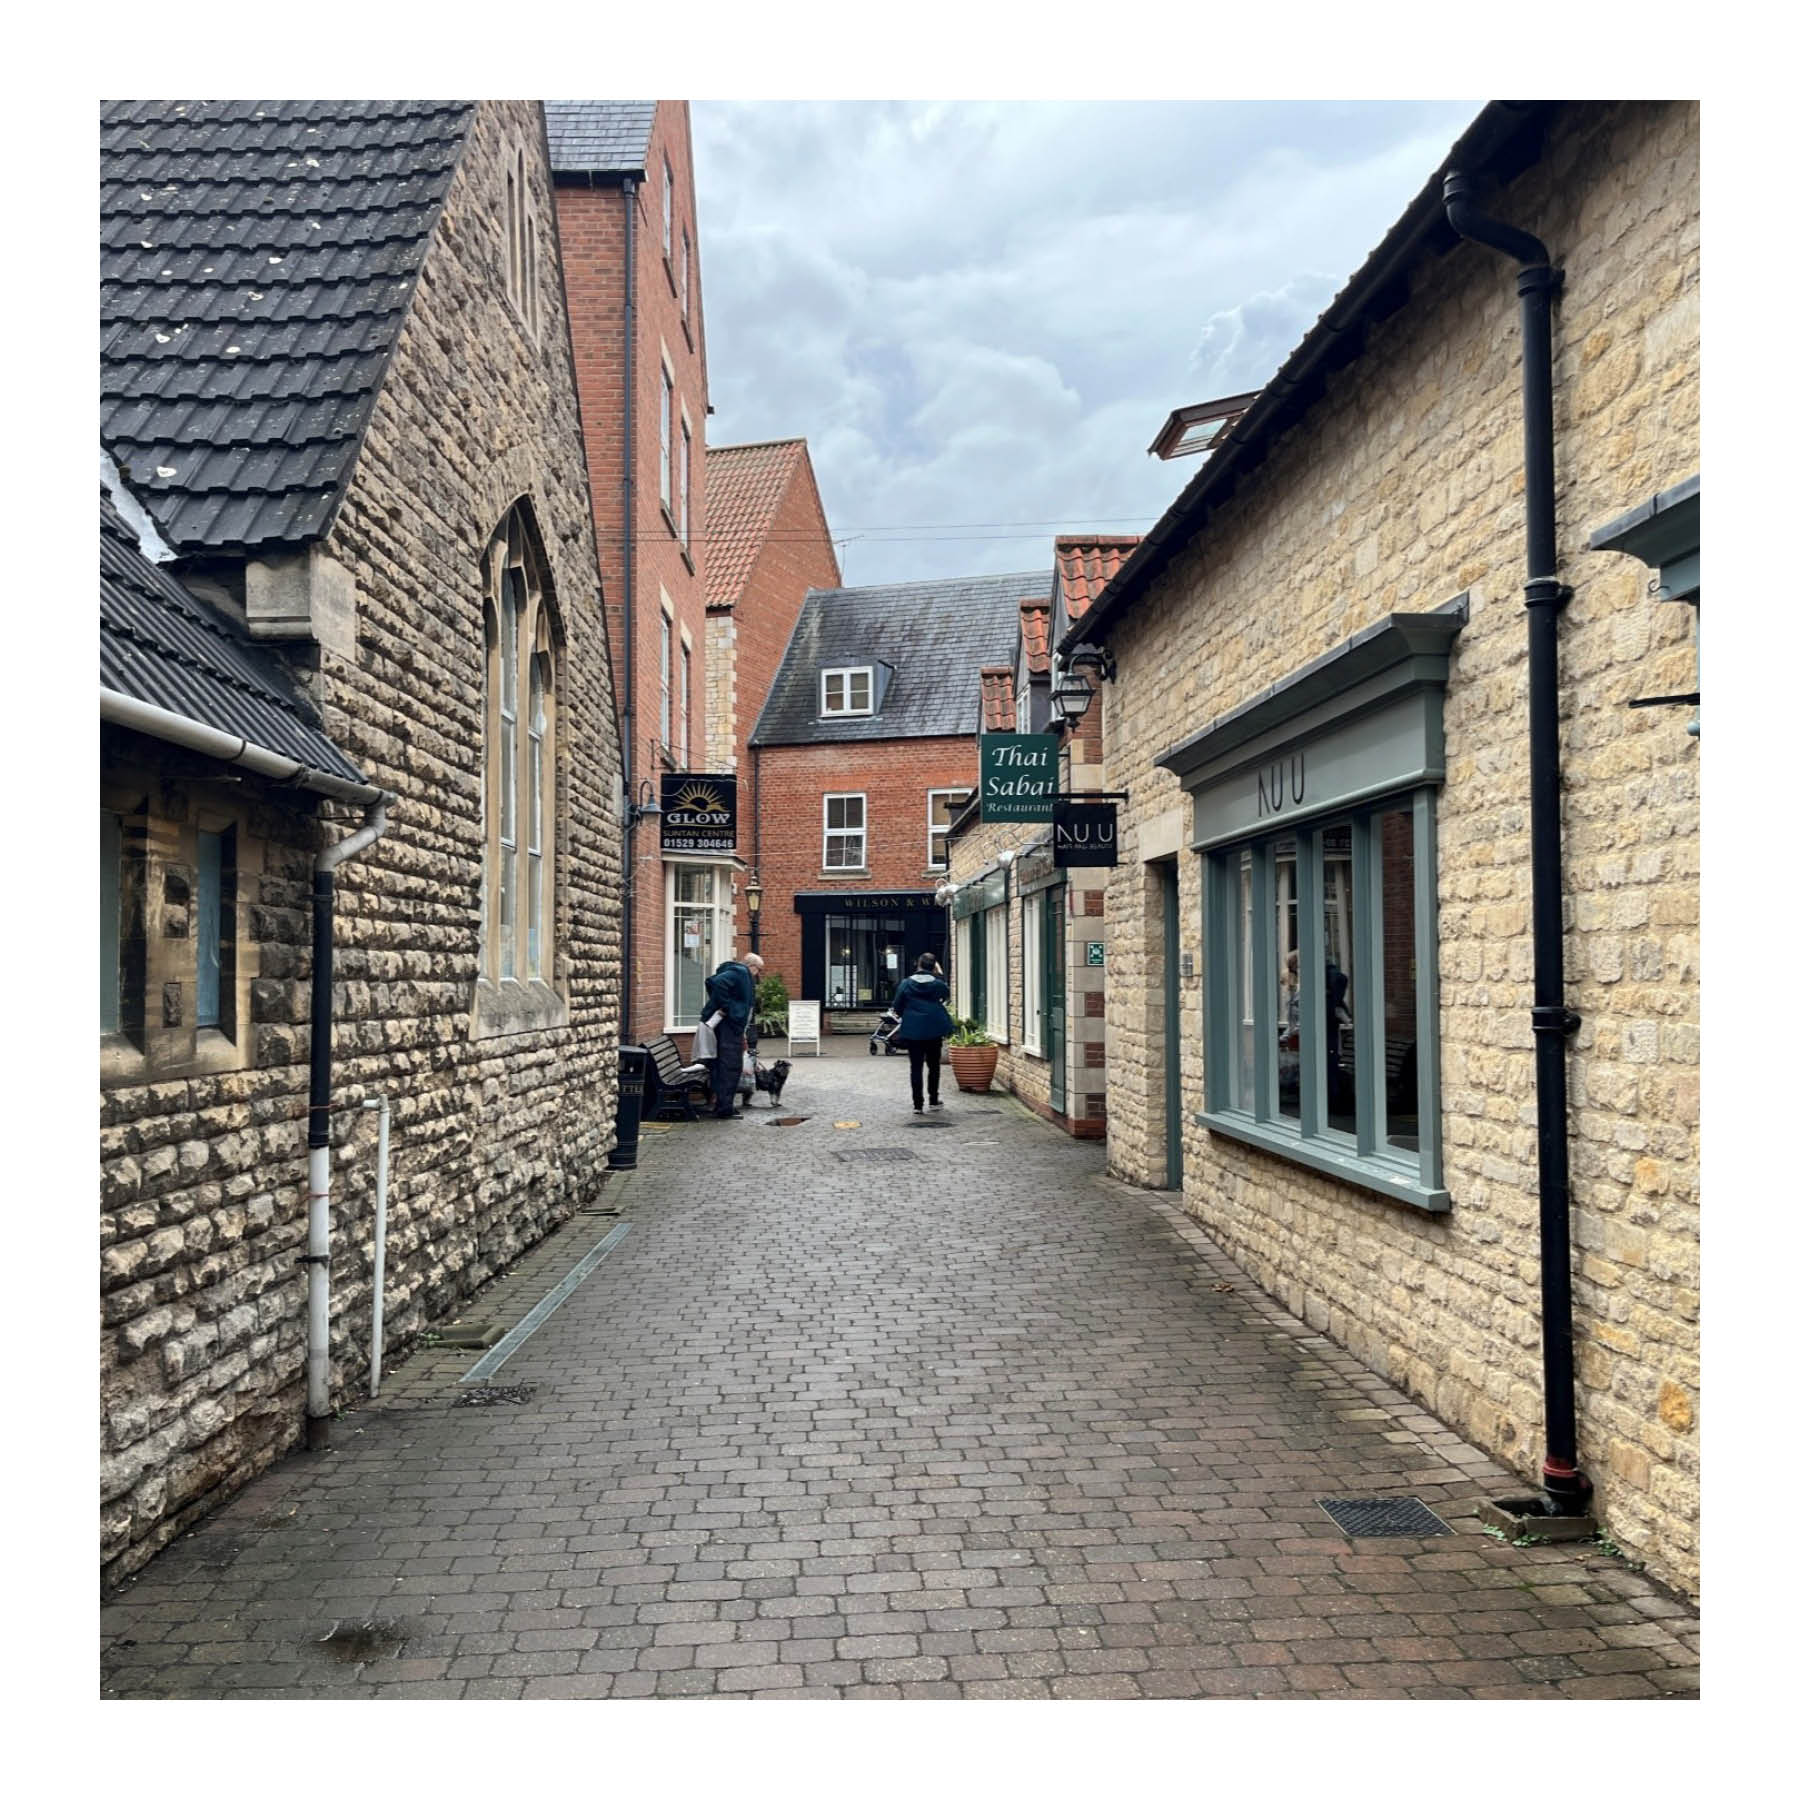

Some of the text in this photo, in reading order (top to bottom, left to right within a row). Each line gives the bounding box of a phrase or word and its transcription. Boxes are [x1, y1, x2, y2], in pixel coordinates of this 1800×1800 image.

[992, 745, 1048, 766] Thai
[986, 775, 1055, 796] Sabai
[987, 803, 1054, 812] Restaurant
[667, 813, 730, 824] GLOW
[664, 839, 694, 847] 01529
[845, 898, 899, 907] WILSON
